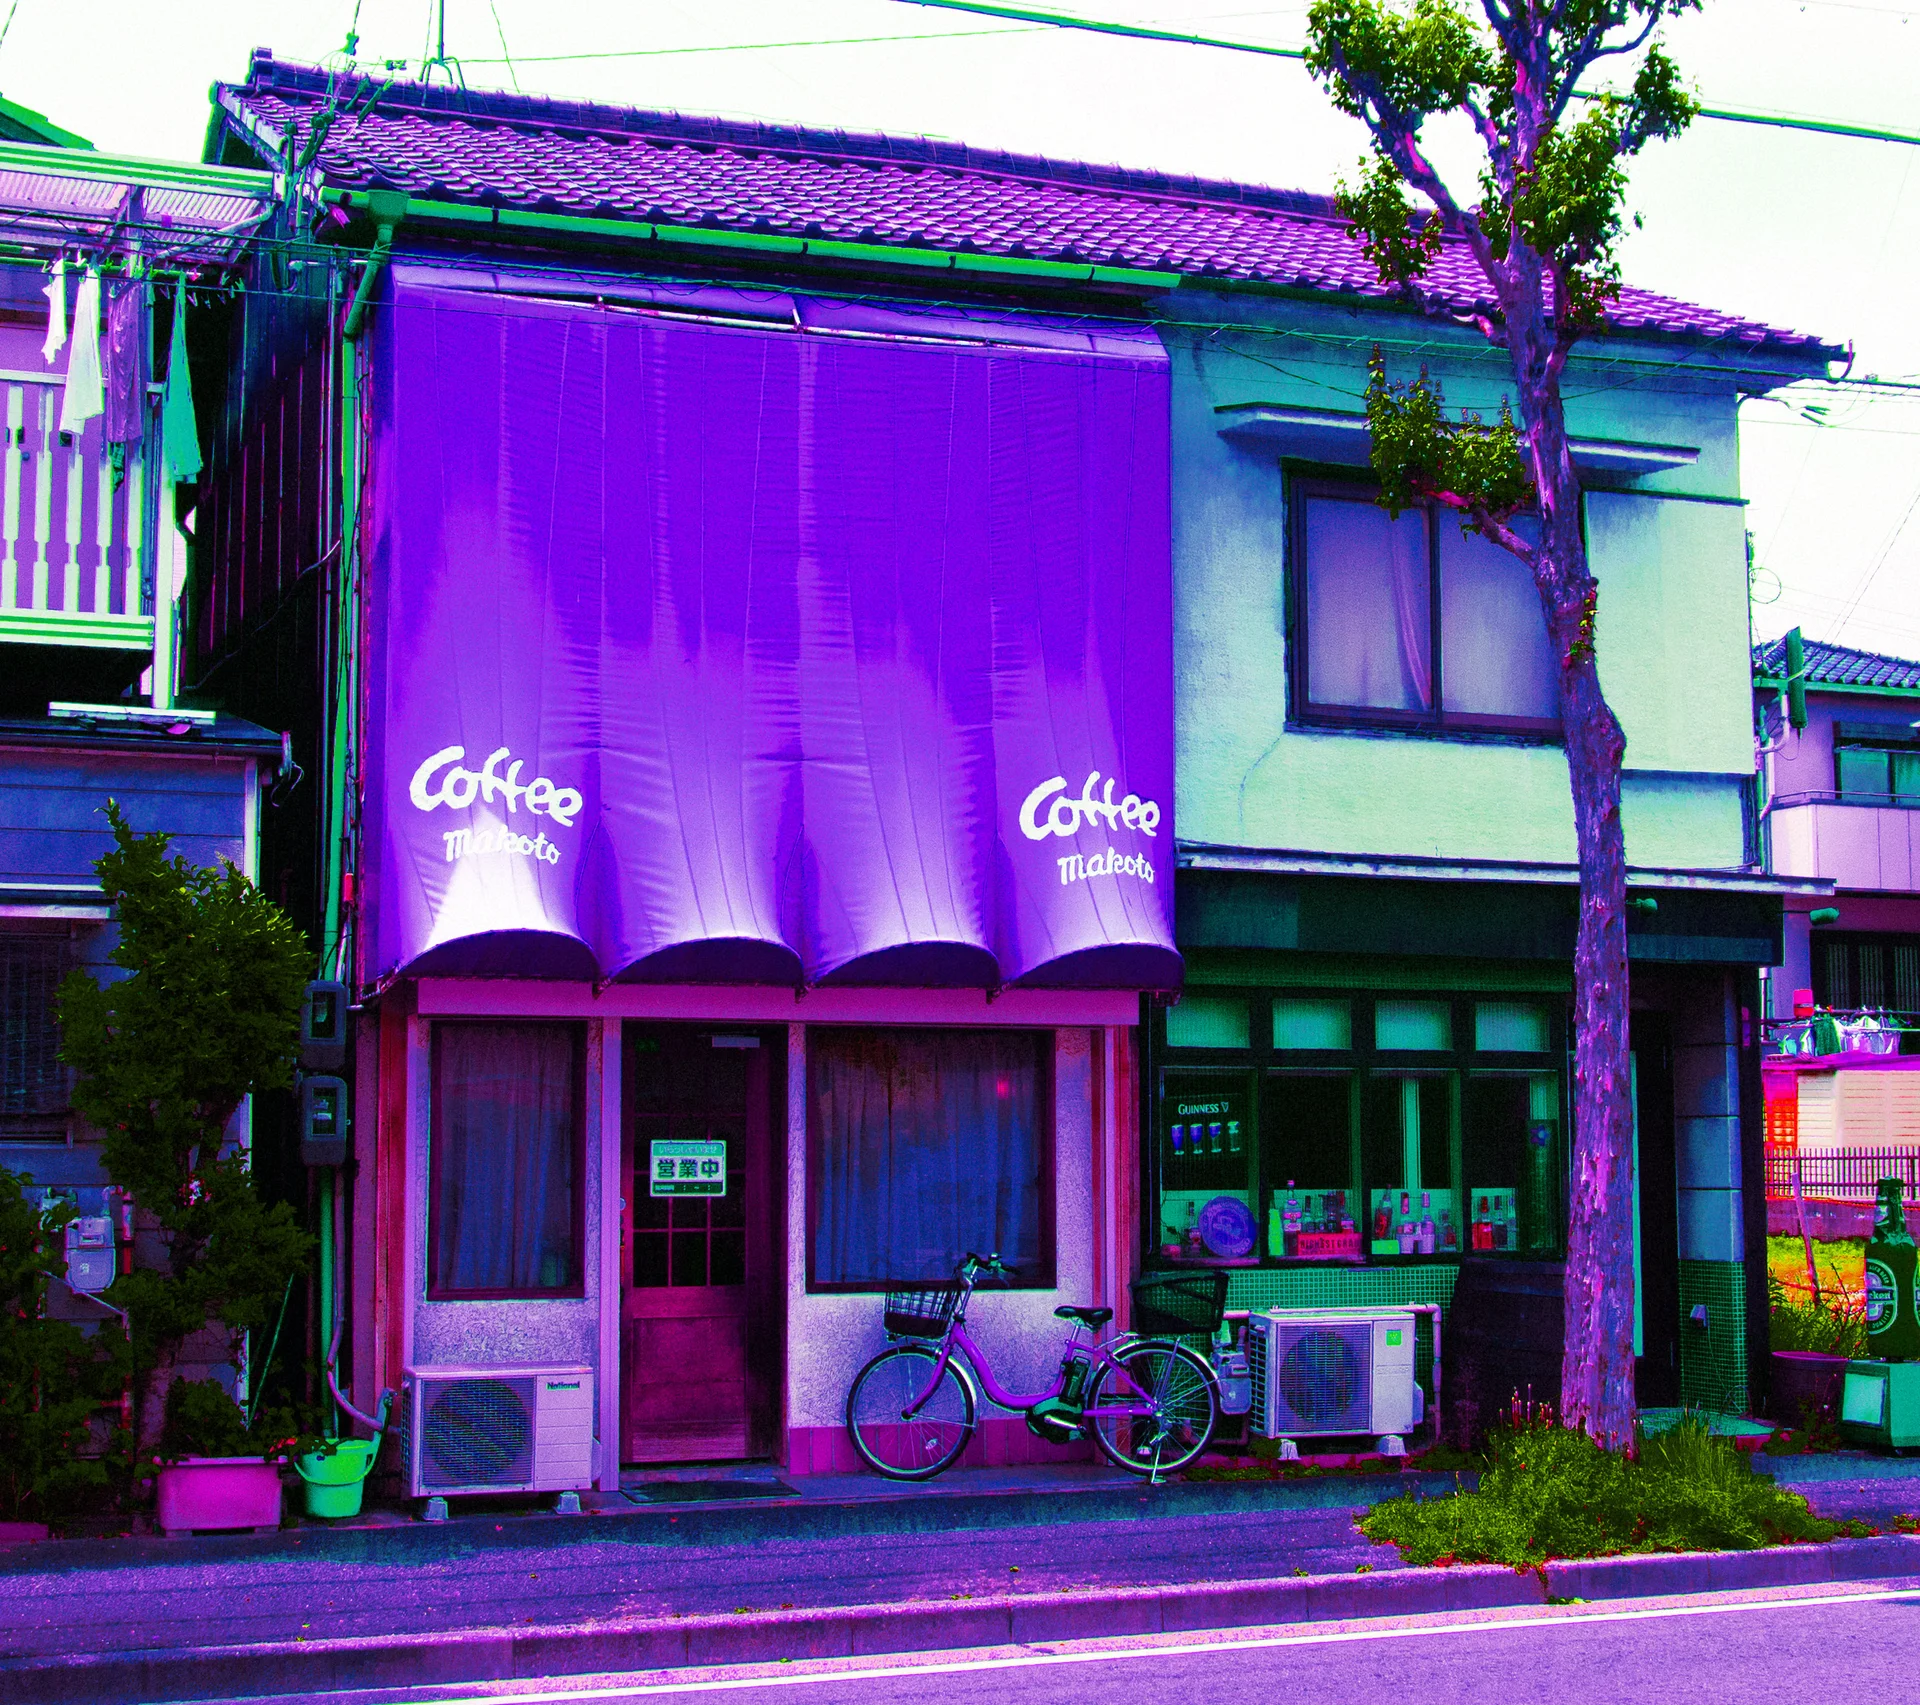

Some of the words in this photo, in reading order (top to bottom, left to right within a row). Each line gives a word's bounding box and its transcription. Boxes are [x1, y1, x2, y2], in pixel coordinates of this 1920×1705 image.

[409, 745, 583, 828] Coffee
[1018, 770, 1161, 841] Coffee
[1178, 1103, 1220, 1115] GUINNESS
[657, 1158, 719, 1178] 営業中
[546, 1381, 579, 1390] National
